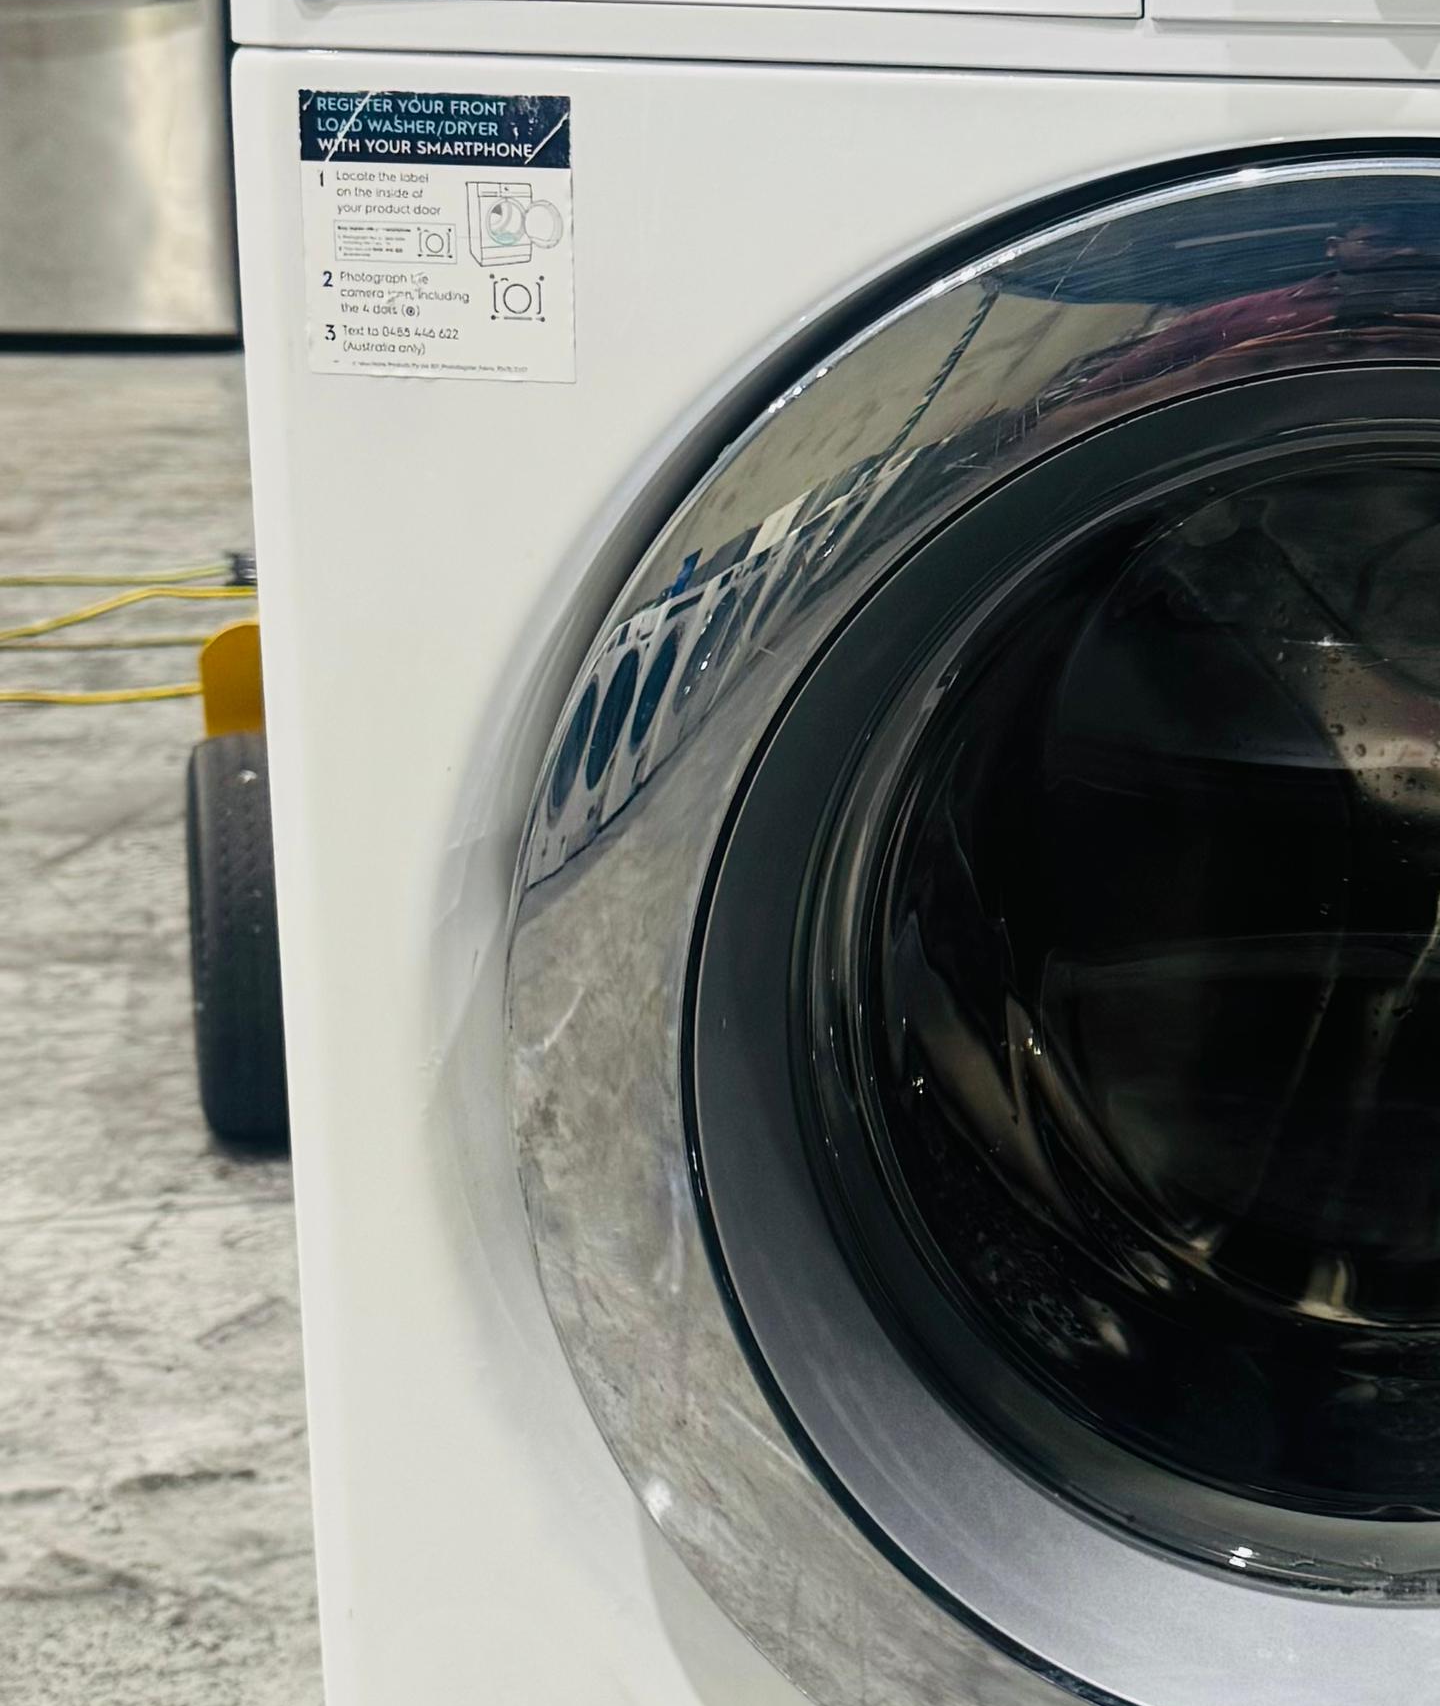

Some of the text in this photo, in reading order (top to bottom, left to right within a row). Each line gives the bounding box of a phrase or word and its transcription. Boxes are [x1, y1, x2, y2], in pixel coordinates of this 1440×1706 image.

[317, 97, 507, 116] REGISTER YOUR FRONT
[317, 118, 499, 137] LOAD WASHER/DRYER
[317, 138, 534, 158] WITH YOUR SMARTPHONE
[336, 171, 429, 183] Locate the label
[336, 186, 424, 199] on the inside of
[337, 204, 442, 215] your product door
[322, 270, 334, 288] 2
[340, 271, 407, 285] Photograph
[340, 288, 384, 299] camera
[341, 302, 359, 313] the
[325, 324, 336, 341] 3
[342, 325, 364, 336] Text
[367, 326, 379, 337] to
